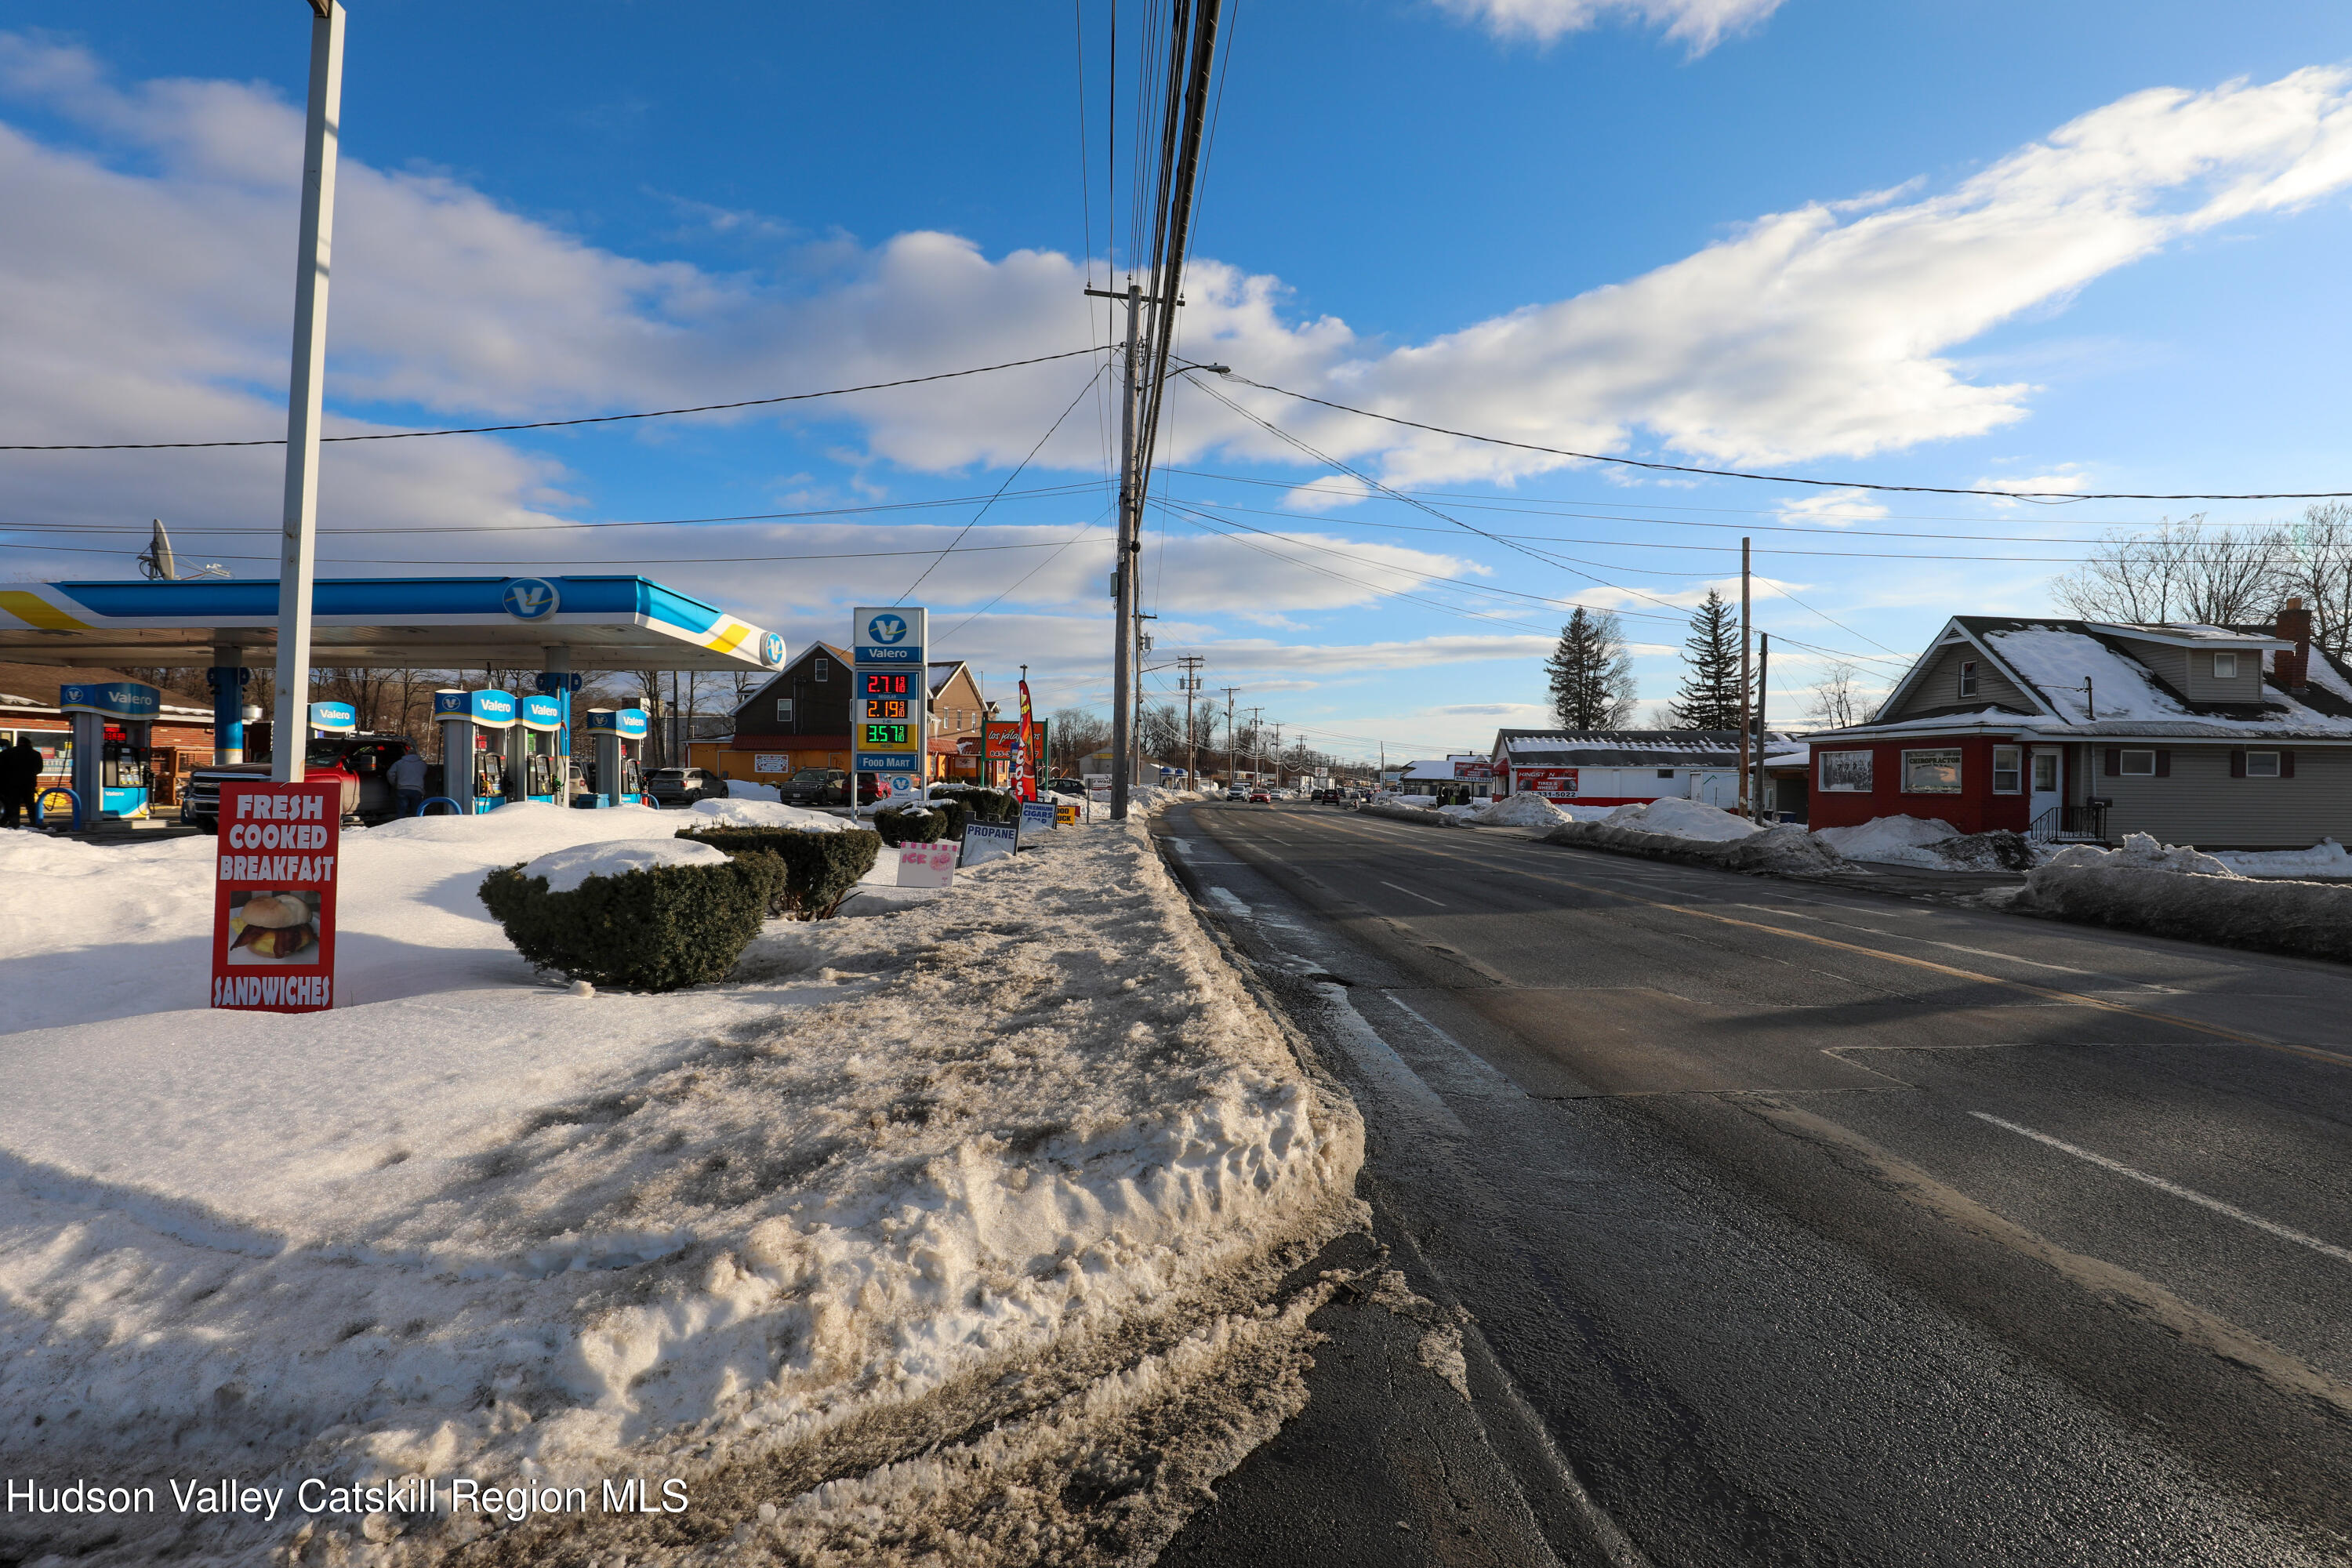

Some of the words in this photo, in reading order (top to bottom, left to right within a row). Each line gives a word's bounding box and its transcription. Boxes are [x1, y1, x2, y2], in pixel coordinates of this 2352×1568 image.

[869, 648, 908, 658] Valero
[108, 691, 153, 705] Valero
[480, 699, 511, 713] Valero
[531, 704, 557, 717] Valero
[319, 709, 350, 720] Valero
[622, 716, 644, 727] Valero
[237, 794, 324, 821] FRESH
[1023, 810, 1053, 818] CIGARS
[229, 824, 328, 849] COOKED
[967, 826, 1015, 840] PROPANE
[902, 852, 927, 865] ICE
[220, 855, 334, 883] BREAKFAST
[213, 975, 330, 1007] SANDWICHES
